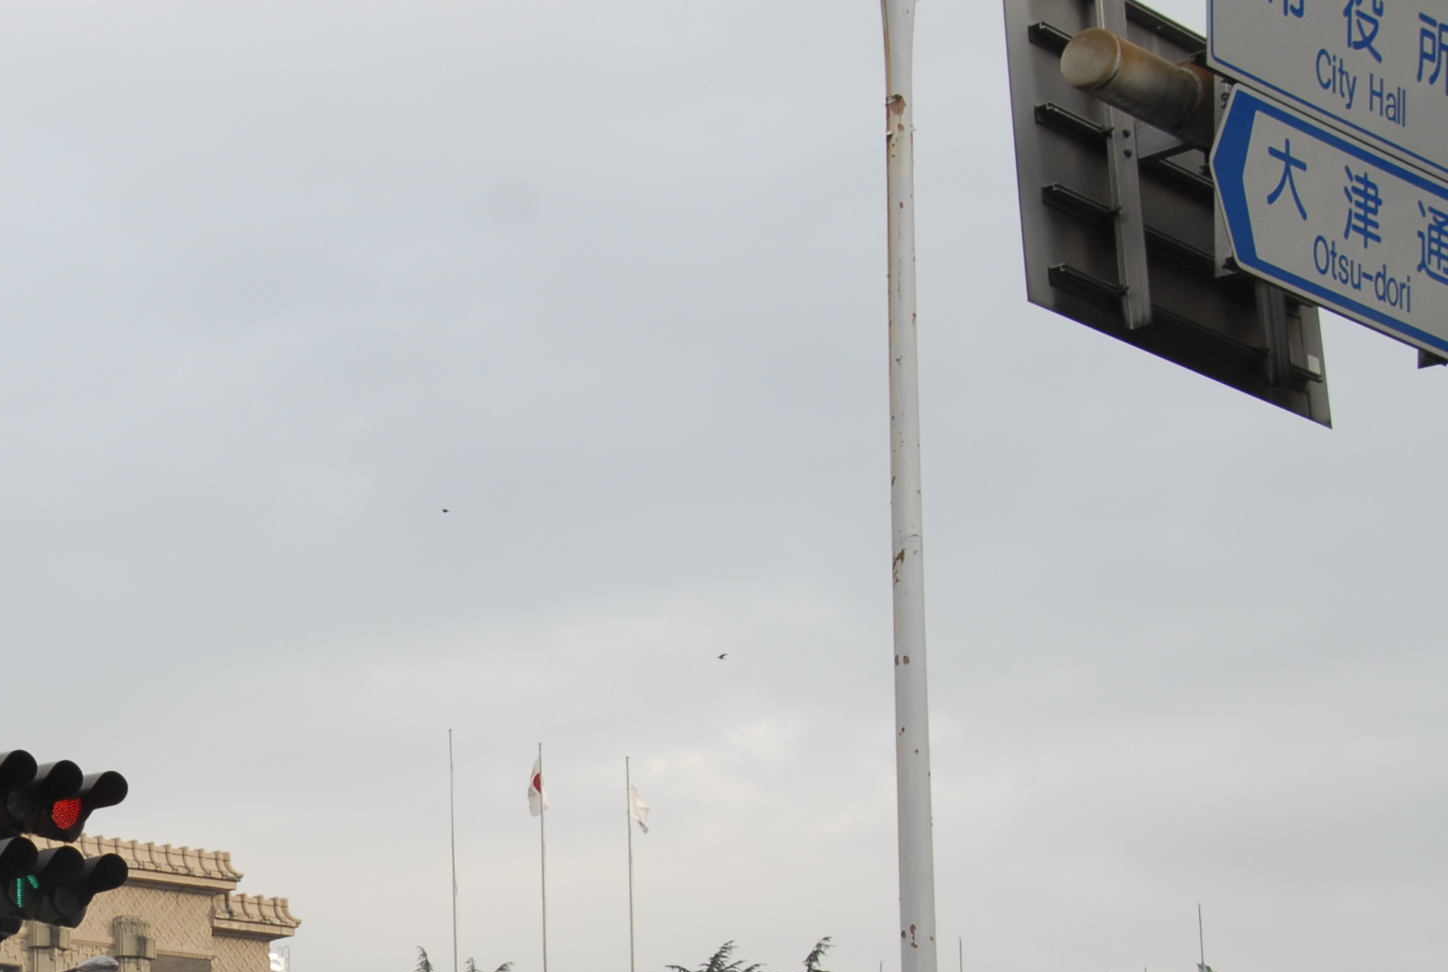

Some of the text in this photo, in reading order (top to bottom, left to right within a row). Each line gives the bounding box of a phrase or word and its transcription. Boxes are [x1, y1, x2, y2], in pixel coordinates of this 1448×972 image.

[1268, 0, 1448, 97] 役所
[1315, 48, 1406, 127] City Hall
[1266, 138, 1448, 286] 大津通
[1313, 235, 1411, 313] Otsu-dori
